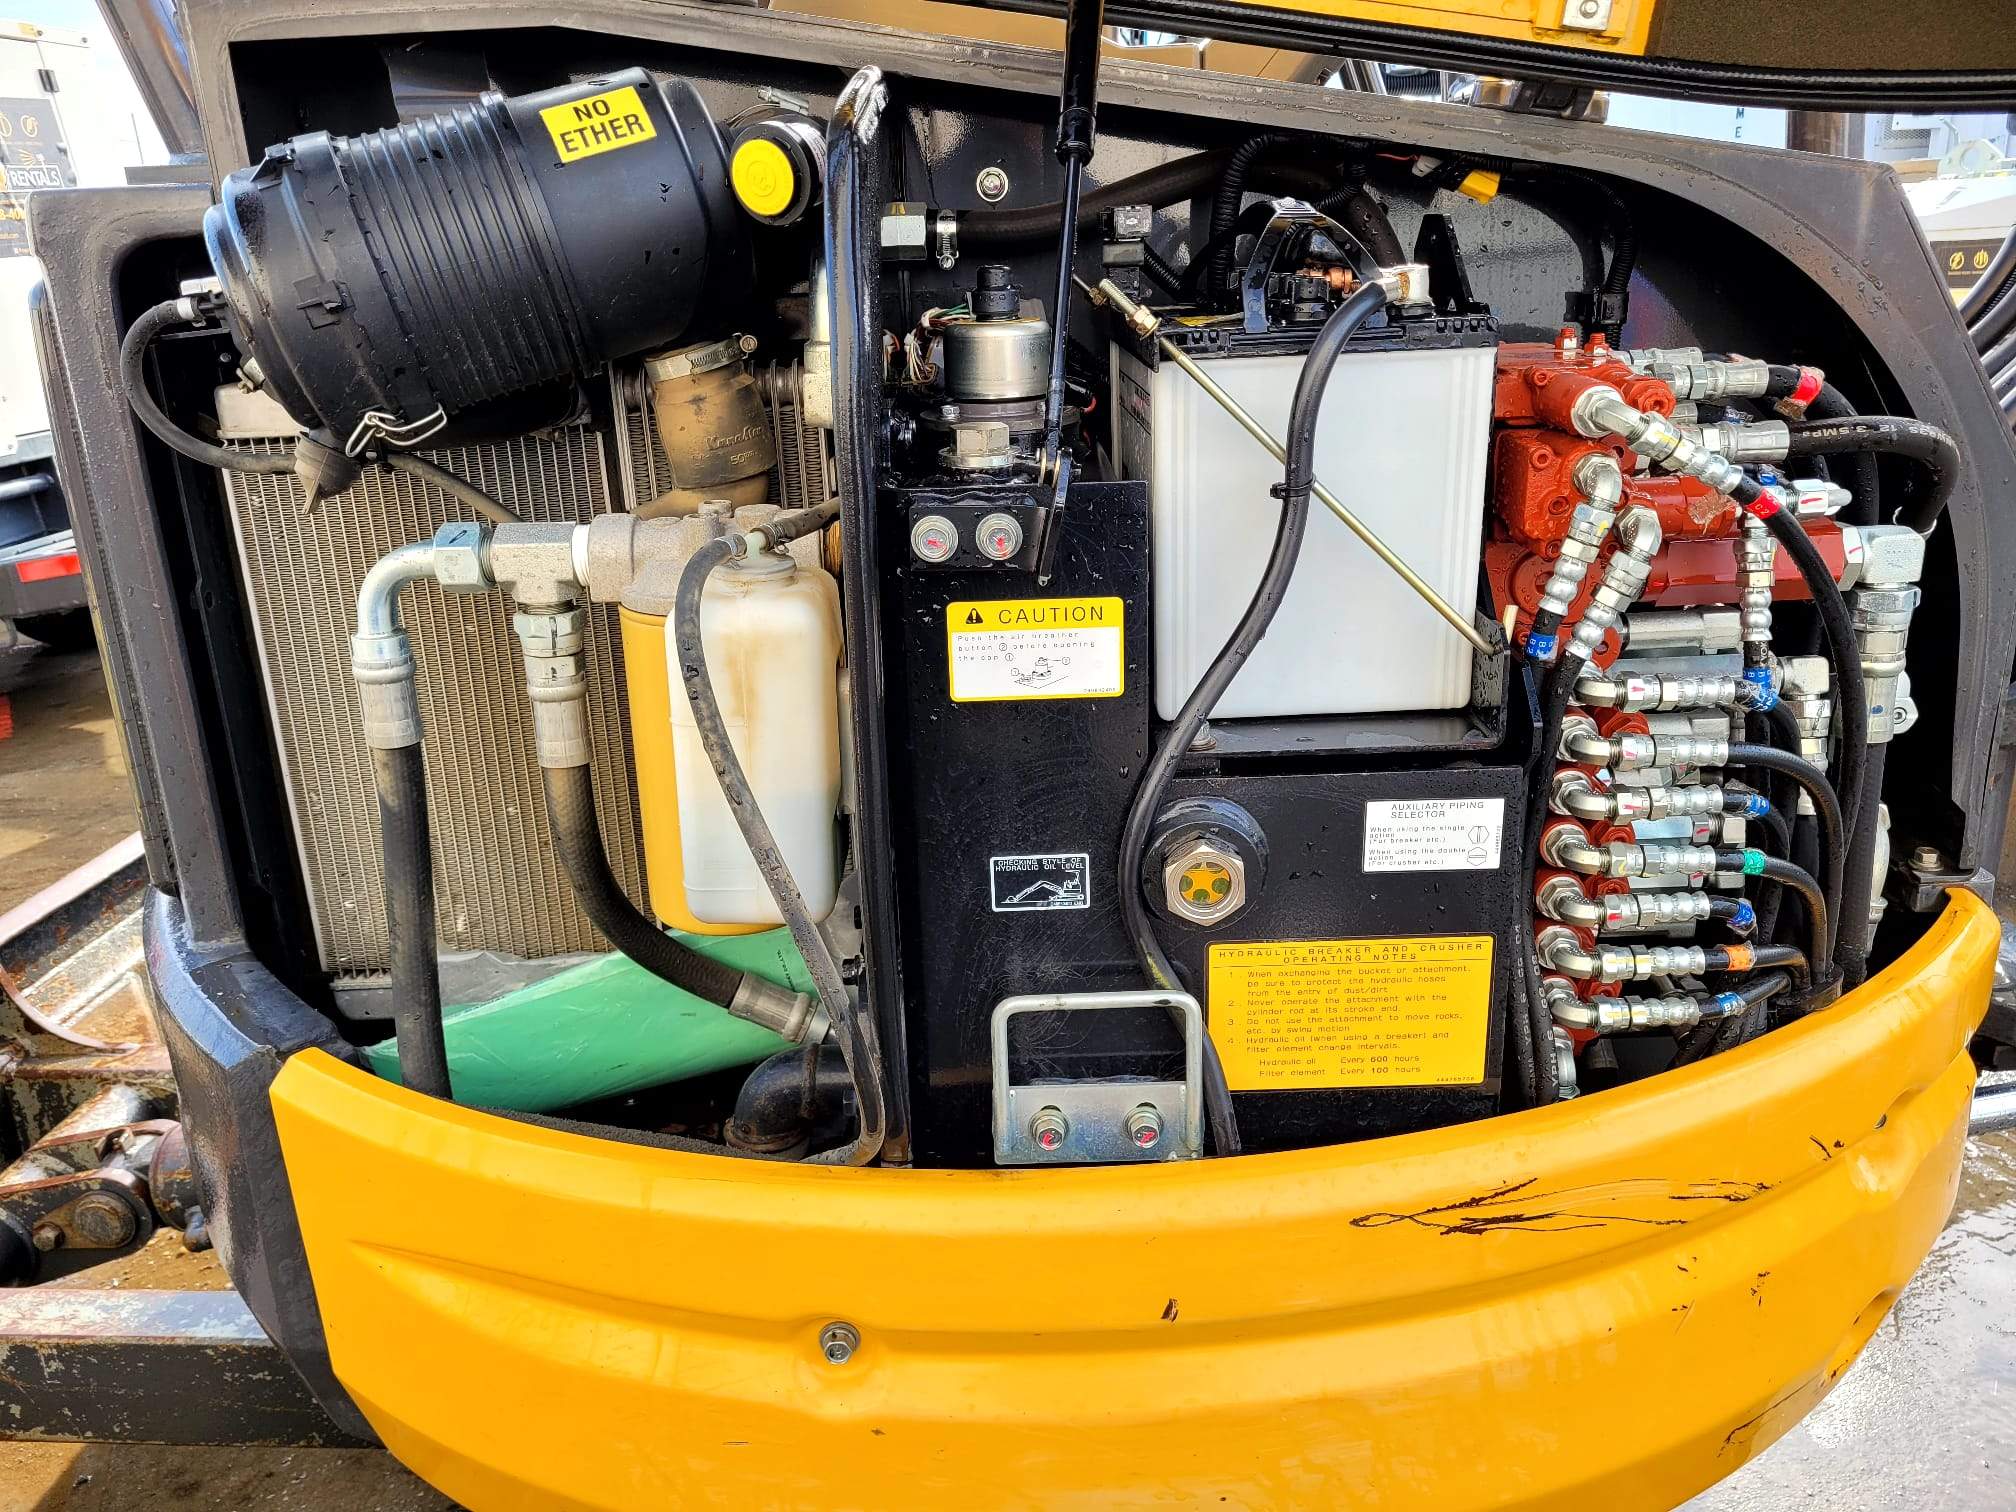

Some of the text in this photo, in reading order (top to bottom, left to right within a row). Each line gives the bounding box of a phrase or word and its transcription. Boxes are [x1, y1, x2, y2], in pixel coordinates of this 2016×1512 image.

[573, 99, 610, 122] NO
[560, 113, 645, 153] ETHER
[10, 169, 61, 187] RENTALS
[999, 605, 1104, 624] CAUTION
[958, 644, 993, 652] button
[1391, 801, 1484, 811] AUXILIARY PIPING
[1391, 811, 1445, 819] SELECTOR
[1395, 848, 1417, 856] using
[995, 864, 1039, 872] HYDRAULIC
[1219, 943, 1483, 958] HYDRAULIC BREAKER AND CRUSHER
[1283, 953, 1417, 963] OPERATING NOTES
[1278, 969, 1330, 978] exchanging
[1413, 965, 1471, 973] attachment.
[1306, 978, 1342, 986] protect
[1370, 976, 1413, 984] hydraulic
[1418, 975, 1446, 983] hoses
[1297, 989, 1321, 997] entry
[1344, 986, 1388, 994] dust/dirt
[1281, 999, 1318, 1007] operate
[1346, 996, 1400, 1004] attachment
[1248, 1009, 1282, 1017] cylinder
[1435, 1012, 1463, 1020] rocks.
[1286, 1026, 1312, 1034] swing
[1521, 1013, 1532, 1046] YPH
[1246, 1036, 1289, 1044] Hydraulic
[1343, 1034, 1368, 1042] using
[1386, 1032, 1426, 1040] breaker)
[1318, 1044, 1352, 1052] change
[1358, 1042, 1401, 1050] intervals.
[1259, 1058, 1301, 1066] Hydraulic
[1340, 1056, 1364, 1065] Every
[1259, 1069, 1286, 1077] Filter
[1340, 1067, 1364, 1075] Every
[1371, 1066, 1389, 1074] 100
[1549, 1053, 1558, 1088] YPH
